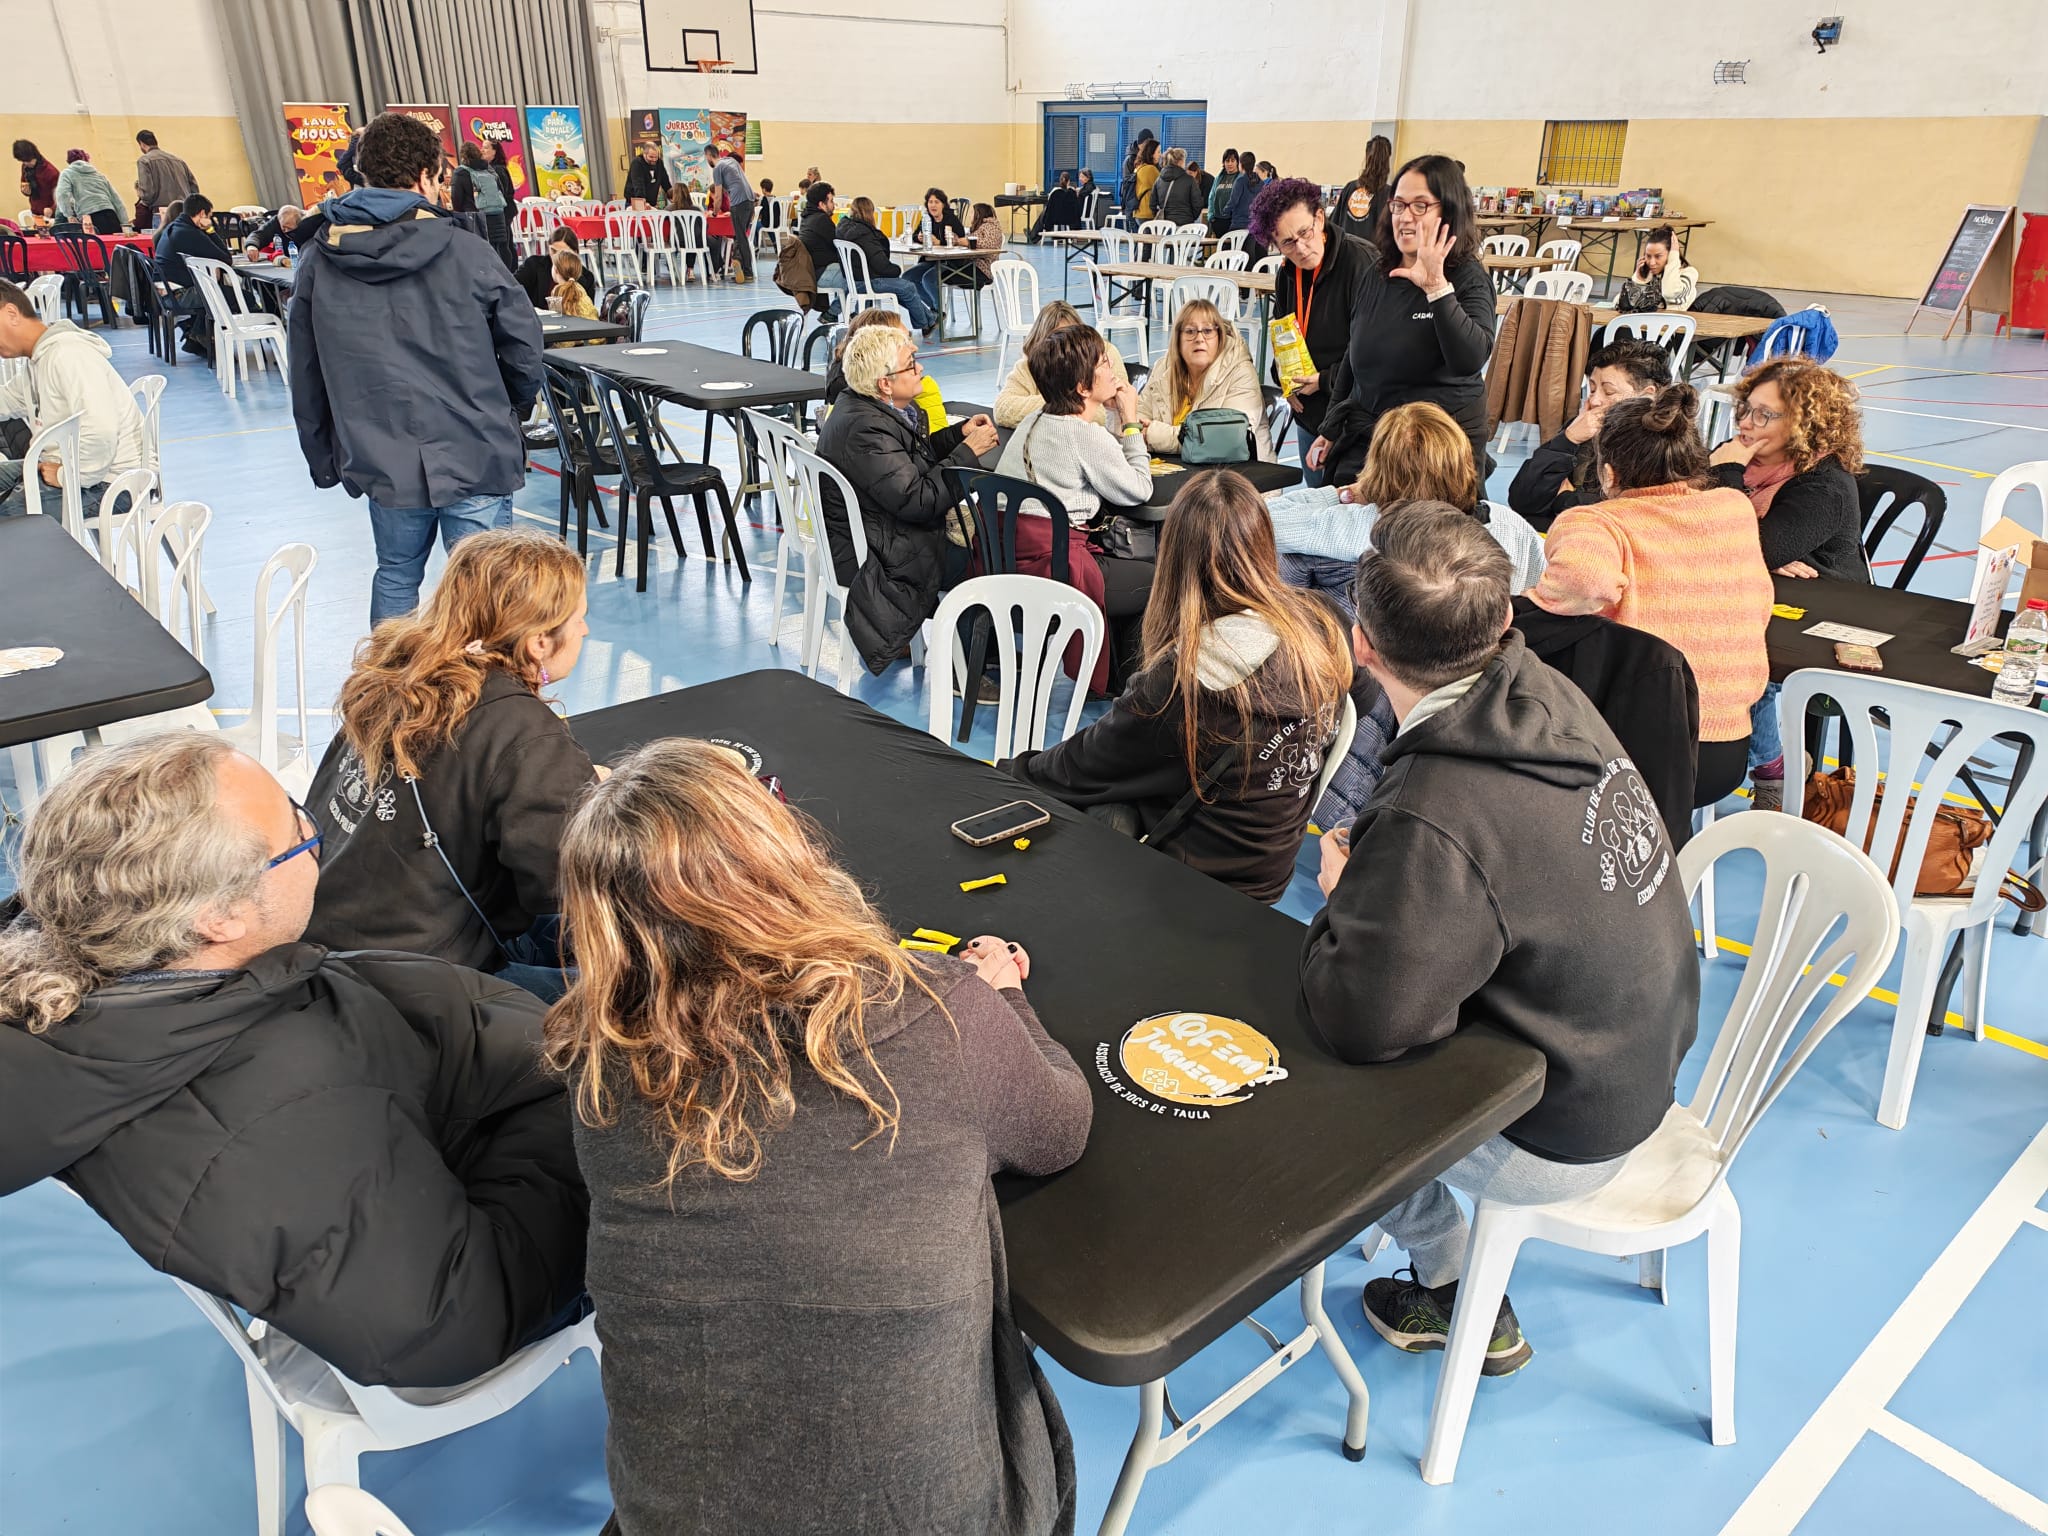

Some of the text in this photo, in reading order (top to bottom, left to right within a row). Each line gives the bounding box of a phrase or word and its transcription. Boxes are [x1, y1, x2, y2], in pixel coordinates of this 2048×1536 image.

[303, 117, 336, 127] LAVA
[665, 121, 700, 131] JURASSIC
[299, 128, 347, 141] HOUSE
[482, 129, 514, 141] PUNCH
[1258, 721, 1297, 761] CLUB DE
[1607, 759, 1621, 776] DE
[1589, 787, 1601, 809] DE
[1582, 808, 1597, 845] CLUB
[1109, 1082, 1126, 1094] DE
[1120, 1090, 1149, 1108] JOCS
[1149, 1103, 1167, 1114] DE
[1173, 1108, 1211, 1120] TAULA
